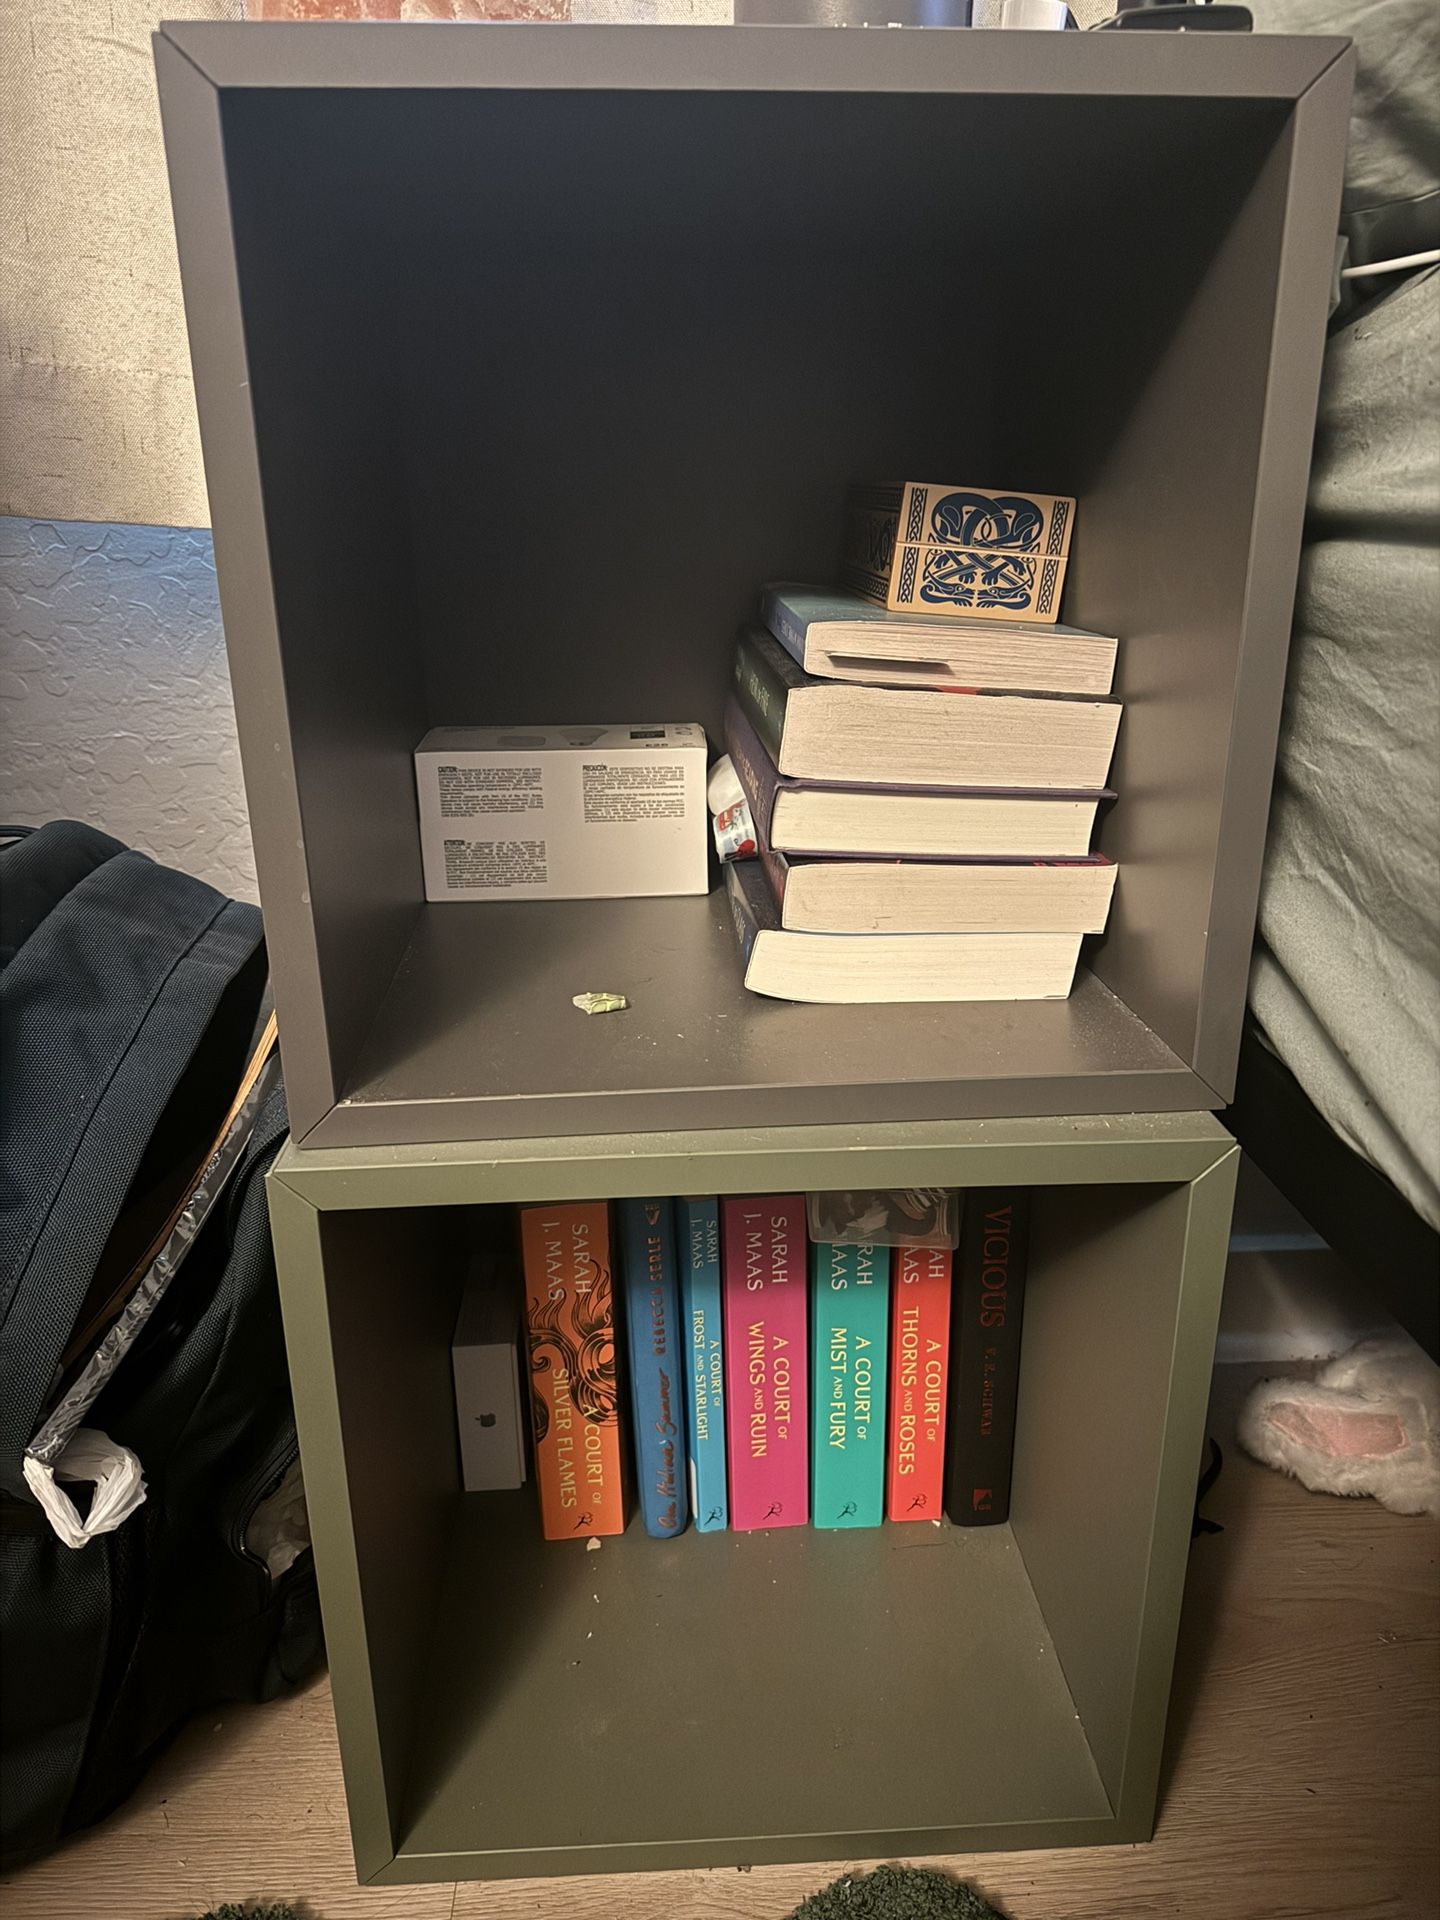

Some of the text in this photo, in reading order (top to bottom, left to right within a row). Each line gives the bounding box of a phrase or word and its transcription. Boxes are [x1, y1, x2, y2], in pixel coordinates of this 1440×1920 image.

[541, 1221, 565, 1300] J. MAAS
[572, 1223, 592, 1293] SARAH
[690, 1218, 704, 1269] J. MAAS
[706, 1220, 718, 1263] SARAH
[743, 1213, 764, 1291] J. MAAS
[771, 1216, 788, 1283] SARAH
[831, 1244, 848, 1290] AAS
[857, 1242, 874, 1284] RAH
[903, 1248, 920, 1284] AAS
[980, 1205, 1012, 1328] VICIOUS
[647, 1236, 666, 1357] REBECCA SERLE
[693, 1309, 709, 1441] FROST AND STARLIGHT
[710, 1340, 720, 1350] A
[710, 1352, 722, 1394] COURT
[656, 1367, 677, 1435] Summer
[748, 1321, 767, 1458] WINGS AND RUIN
[773, 1336, 790, 1440] A COURT OF
[829, 1327, 848, 1450] MIST AND FURY
[854, 1336, 872, 1440] A COURT OF
[898, 1305, 919, 1475] THORNS AND ROSES
[924, 1339, 942, 1441] A COURT OF
[552, 1368, 577, 1508] SILVER FLAMES
[583, 1404, 603, 1505] A COURT OF
